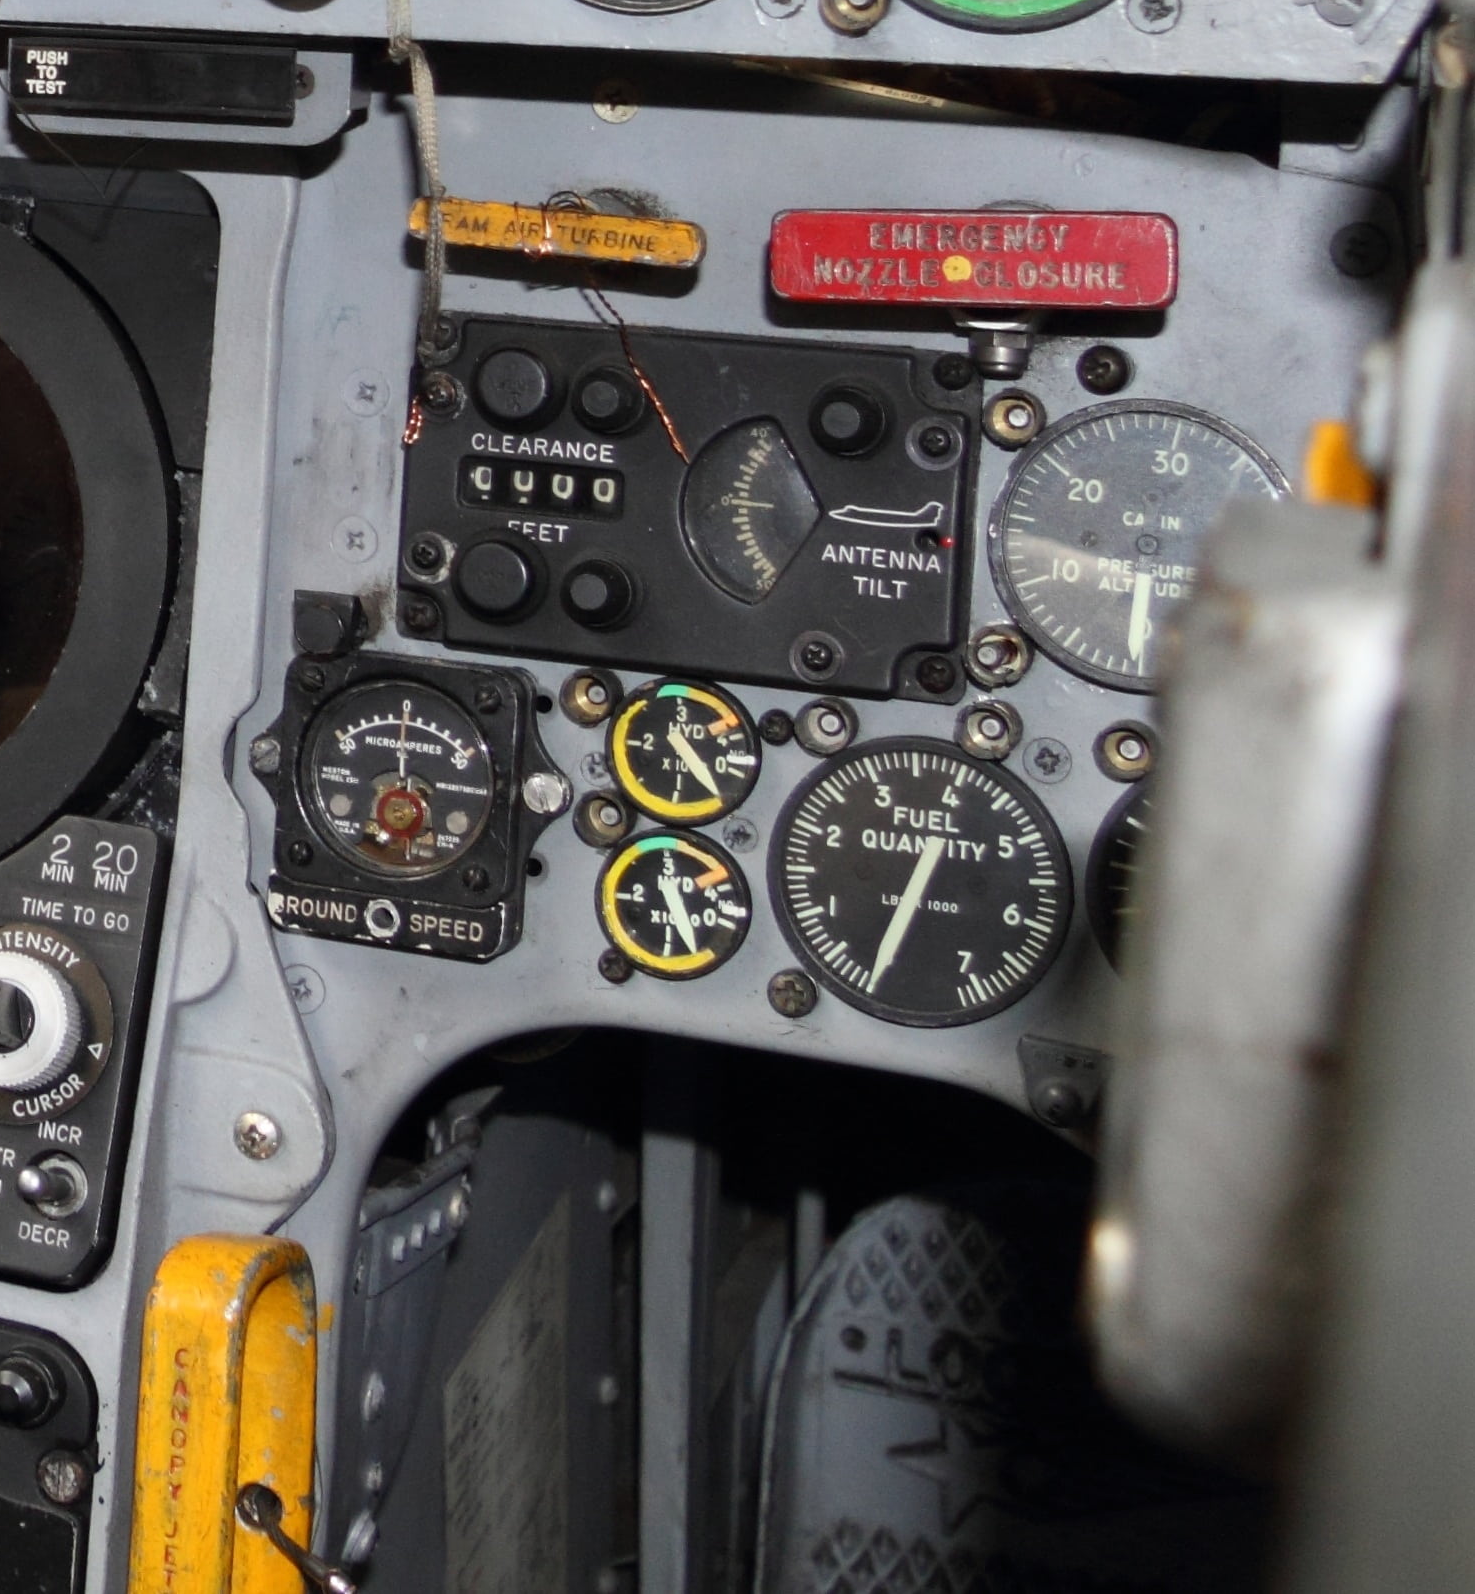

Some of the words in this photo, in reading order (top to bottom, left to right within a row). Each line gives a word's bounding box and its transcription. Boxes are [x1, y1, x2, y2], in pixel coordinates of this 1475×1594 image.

[27, 50, 68, 65] PUSH
[27, 80, 66, 94] TEST
[869, 223, 1069, 252] EMERGENCY
[814, 254, 939, 288] NOZZLE
[974, 260, 1127, 290] CLOSURE
[471, 433, 614, 463] CLEARANCE
[821, 545, 941, 573] ANTENNA
[853, 576, 907, 599] TILT
[894, 806, 959, 833] FUEL
[41, 862, 74, 885] MIN
[94, 873, 127, 893] MIN
[21, 898, 63, 921] TIME
[73, 907, 95, 925] TO
[103, 912, 130, 931] GO
[409, 915, 483, 943] SPEED
[12, 1073, 85, 1118] CURSOR
[37, 1122, 82, 1144] INCR
[18, 1221, 69, 1248] DECR
[168, 1347, 190, 1500] CANOPY
